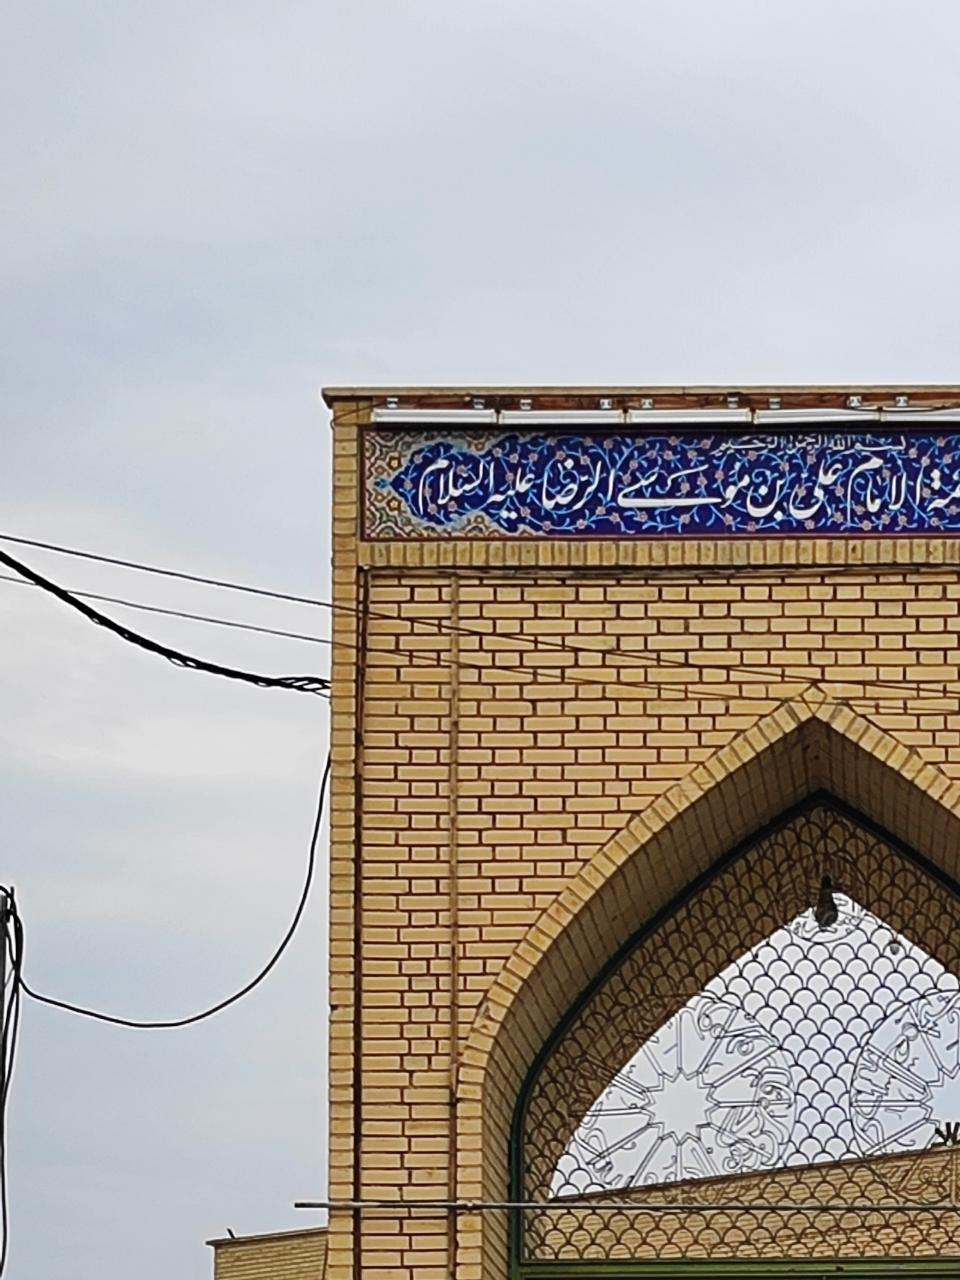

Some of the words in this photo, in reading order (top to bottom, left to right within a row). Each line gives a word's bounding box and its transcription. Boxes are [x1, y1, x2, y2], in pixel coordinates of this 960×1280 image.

[418, 458, 496, 515] السلام
[486, 467, 536, 519] علیه
[542, 458, 616, 511] الرضا
[747, 478, 786, 522] بن
[847, 456, 925, 526] الامام
